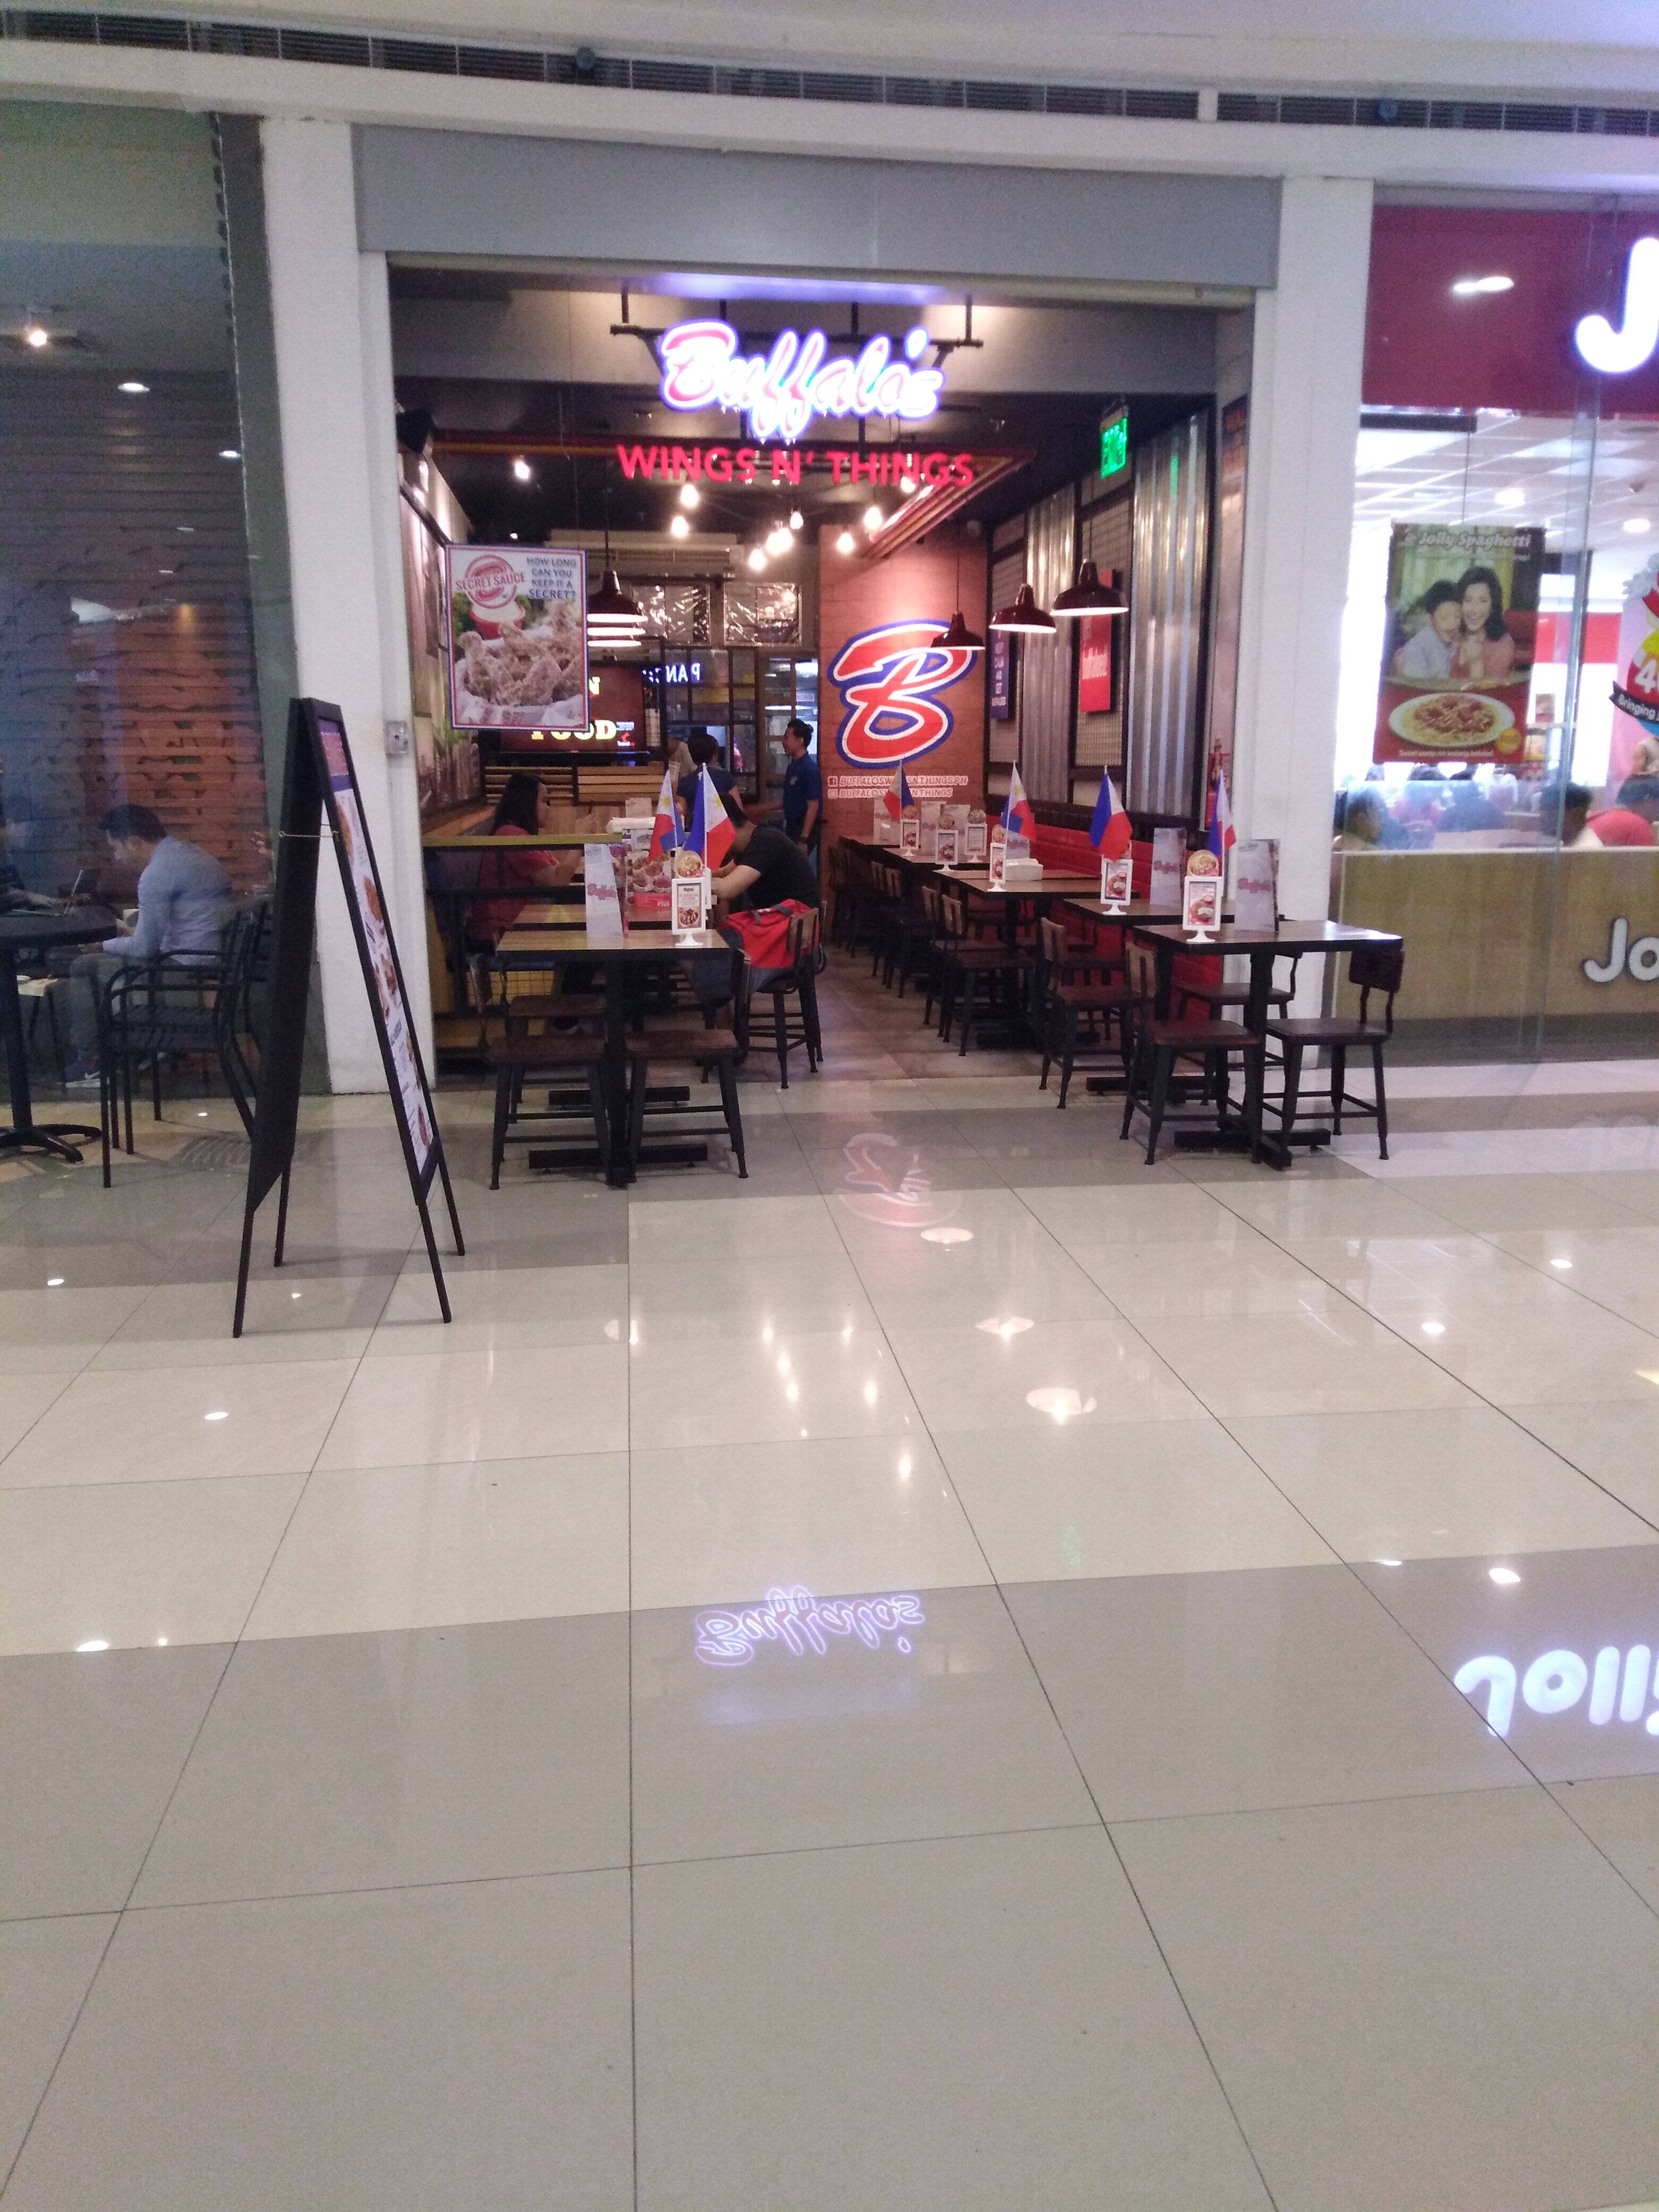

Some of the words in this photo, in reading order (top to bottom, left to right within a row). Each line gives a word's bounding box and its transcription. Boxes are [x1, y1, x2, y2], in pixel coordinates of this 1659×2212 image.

[661, 320, 944, 438] Buffalo's
[617, 445, 757, 480] WINGS
[772, 450, 815, 483] N'
[826, 451, 974, 487] THINGS
[527, 557, 548, 566] HOW
[551, 558, 576, 567] LONG
[553, 569, 572, 578] YOU
[456, 577, 492, 591] SECRET
[493, 572, 525, 585] SAUCE
[529, 589, 576, 599] SECRET?
[1618, 693, 1656, 720] Bringing
[1585, 918, 1659, 983] Jo
